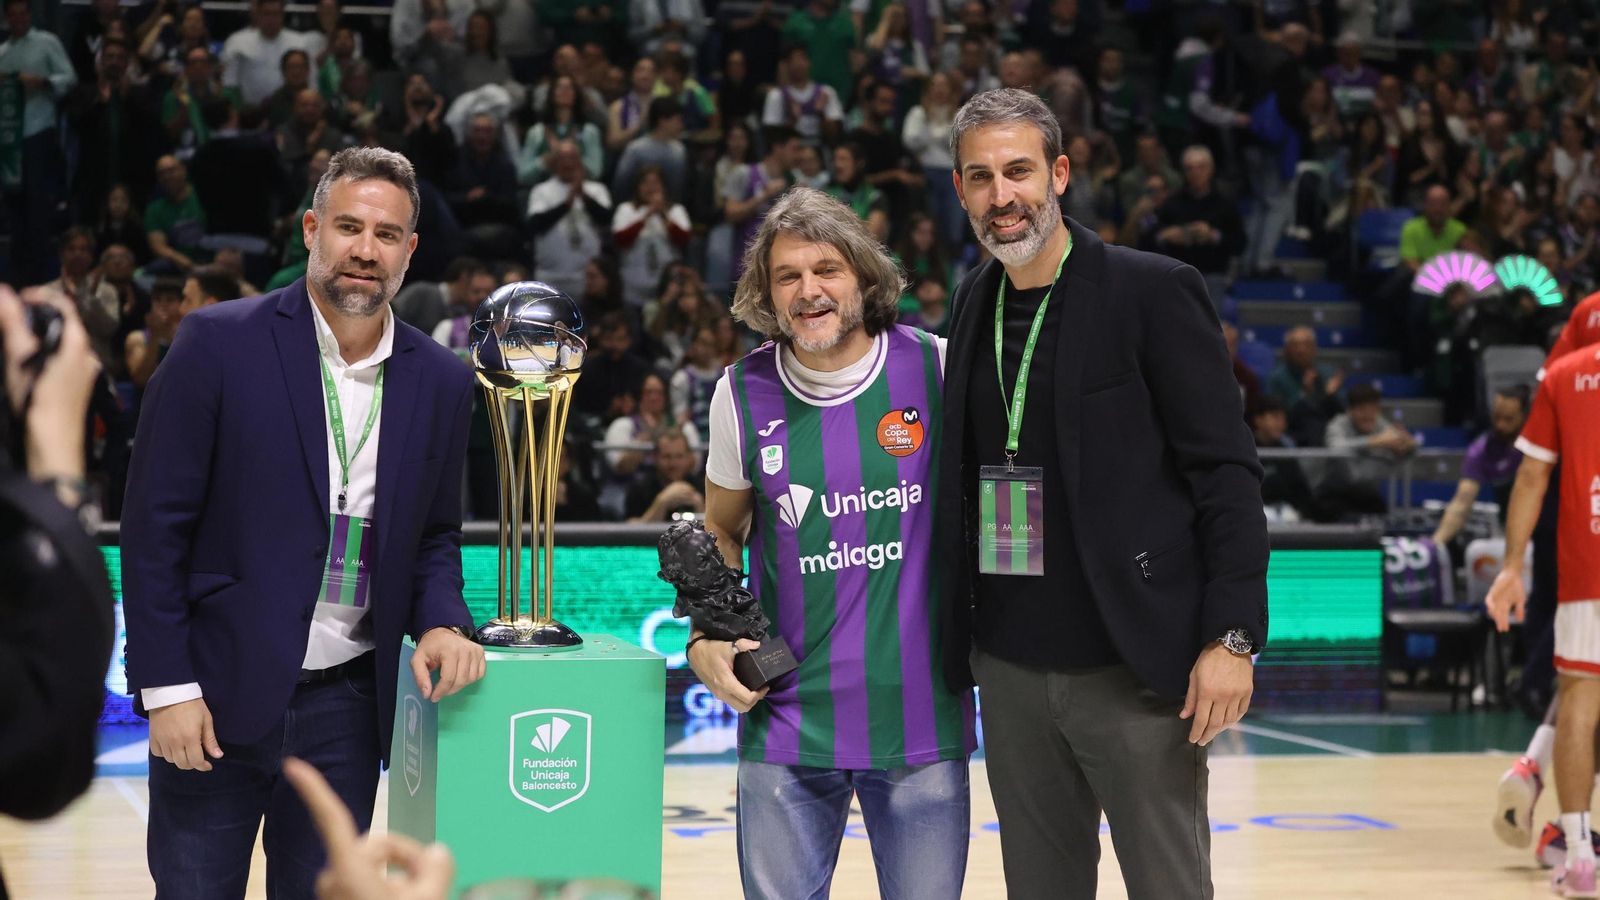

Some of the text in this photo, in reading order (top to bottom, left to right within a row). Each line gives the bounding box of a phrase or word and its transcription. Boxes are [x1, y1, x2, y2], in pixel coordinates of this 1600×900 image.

[884, 429, 908, 438] Copa
[896, 436, 912, 444] Rey
[820, 479, 922, 518] Unicaja
[987, 522, 1034, 532] PG AA AAA
[335, 556, 345, 564] AA
[351, 559, 364, 567] AAA
[522, 757, 577, 769] Fundación
[530, 770, 570, 781] Unicaja
[522, 781, 577, 790] Baloncesto
